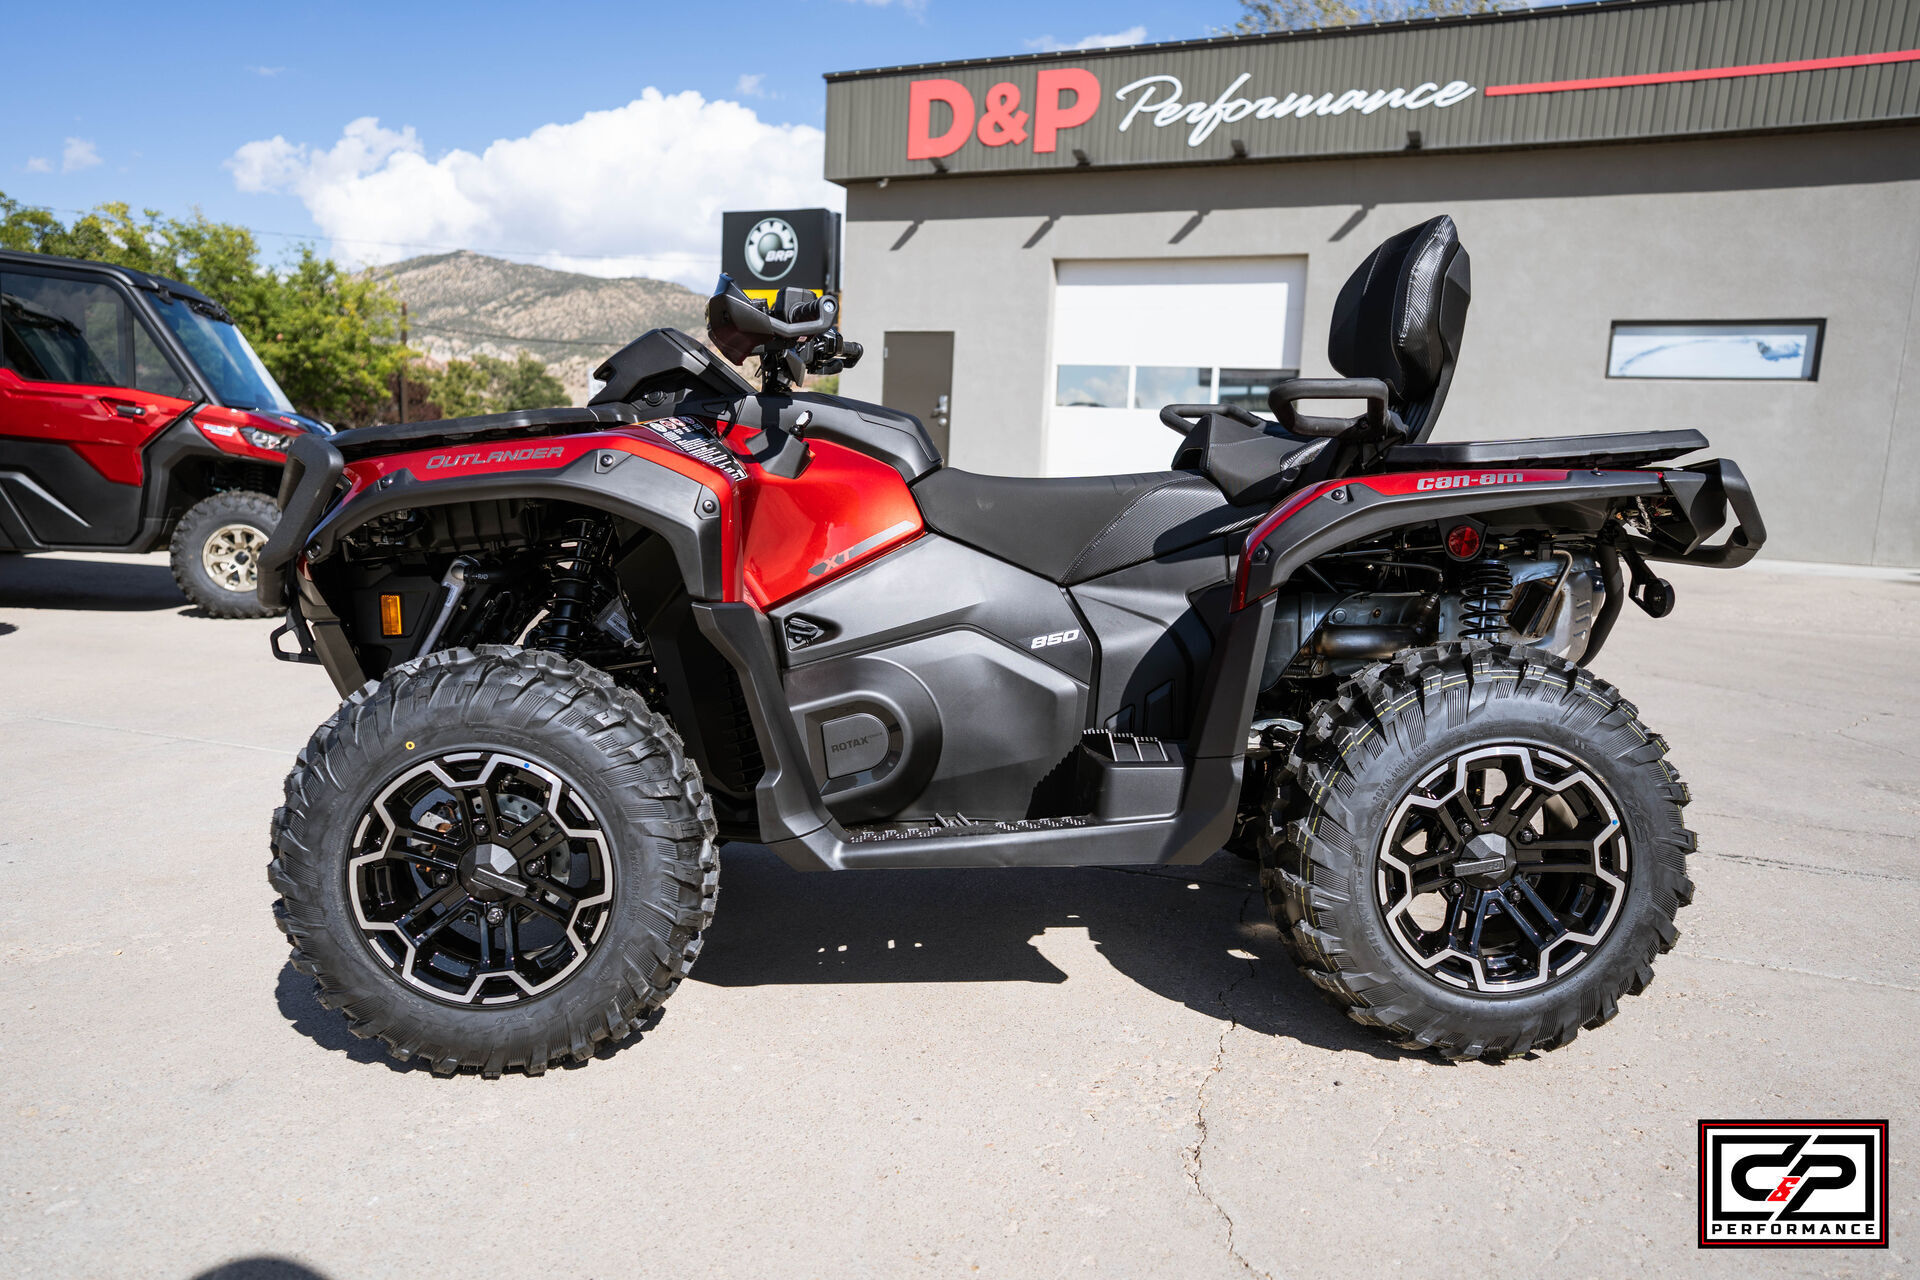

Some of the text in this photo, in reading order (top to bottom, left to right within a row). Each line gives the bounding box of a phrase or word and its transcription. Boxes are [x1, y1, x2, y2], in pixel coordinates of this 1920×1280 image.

[906, 67, 1476, 160] D&P Performance
[765, 249, 794, 262] BRP
[426, 446, 564, 469] OUTLANDER
[1417, 472, 1523, 491] can-am
[1030, 629, 1080, 650] 850
[831, 735, 869, 753] ROTAX
